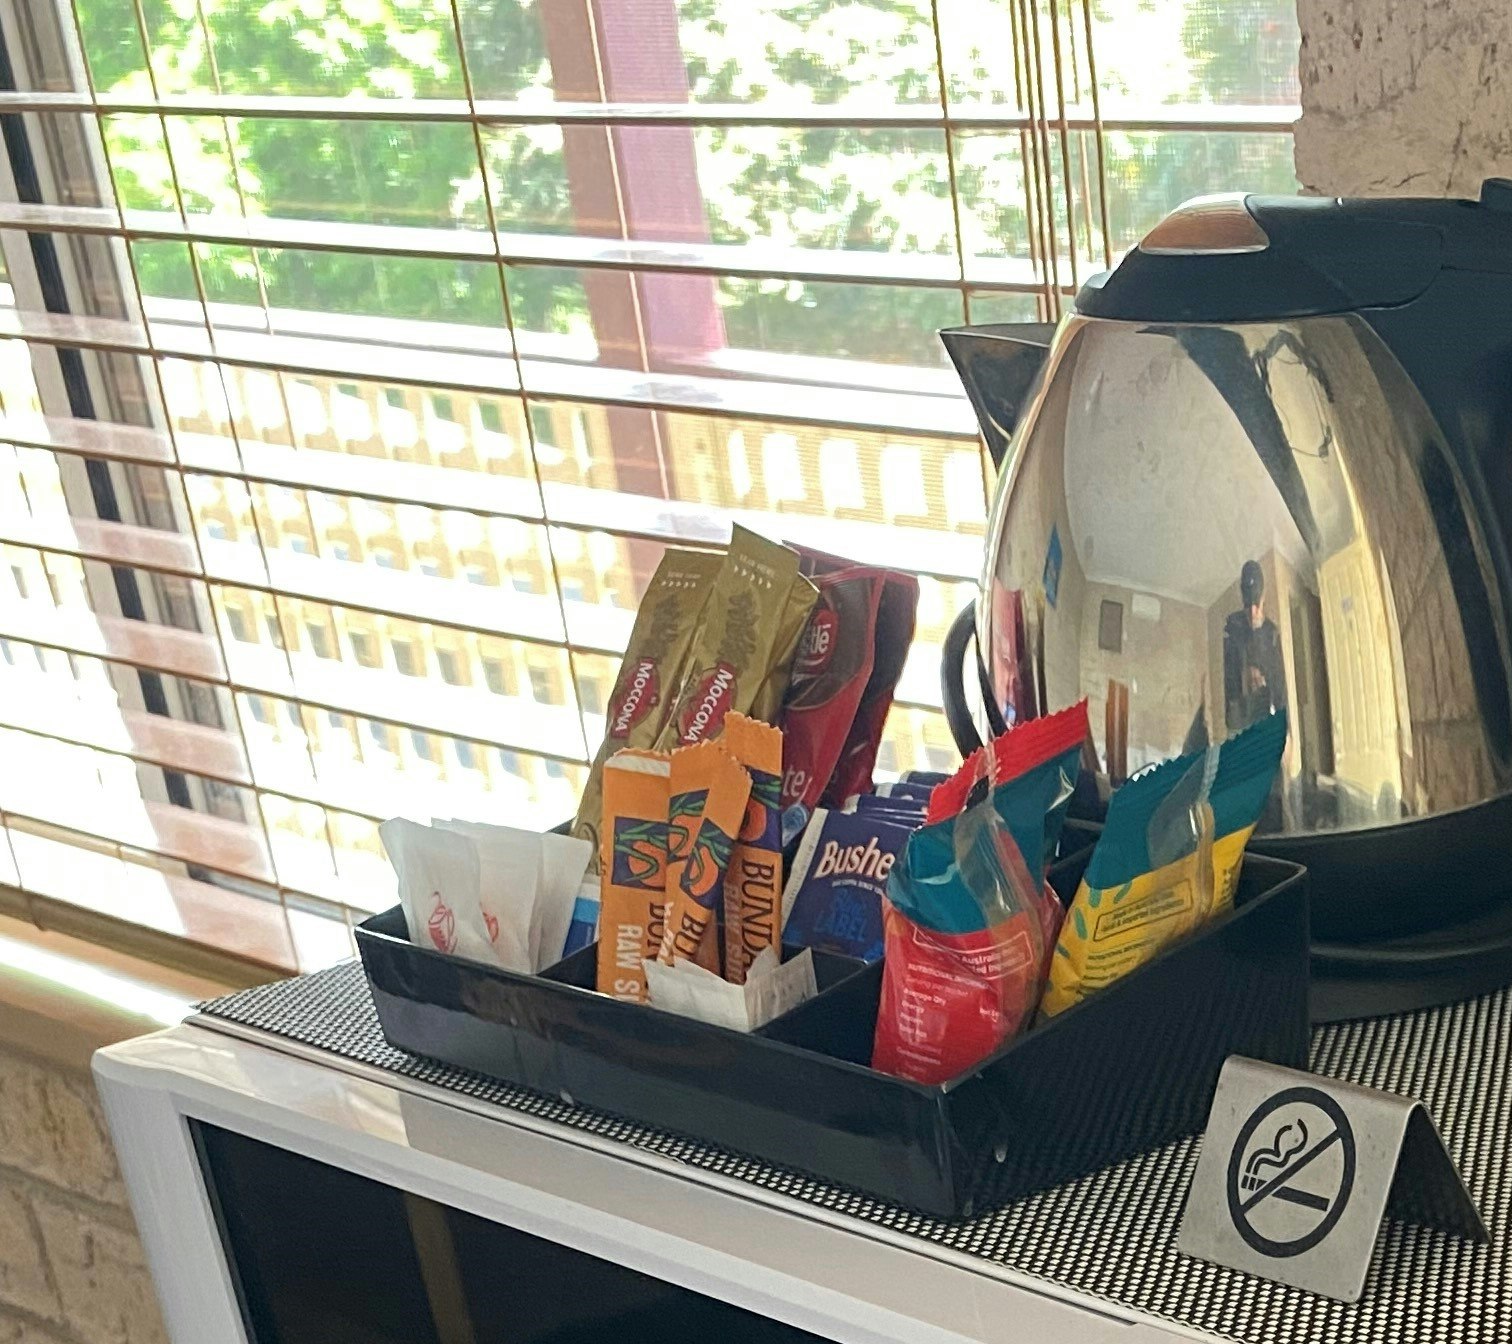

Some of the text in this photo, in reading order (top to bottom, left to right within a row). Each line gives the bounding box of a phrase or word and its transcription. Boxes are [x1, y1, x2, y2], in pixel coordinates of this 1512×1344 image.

[615, 662, 653, 732] MOCCONA
[683, 668, 734, 742] MOCCONA
[616, 924, 643, 970] RAW
